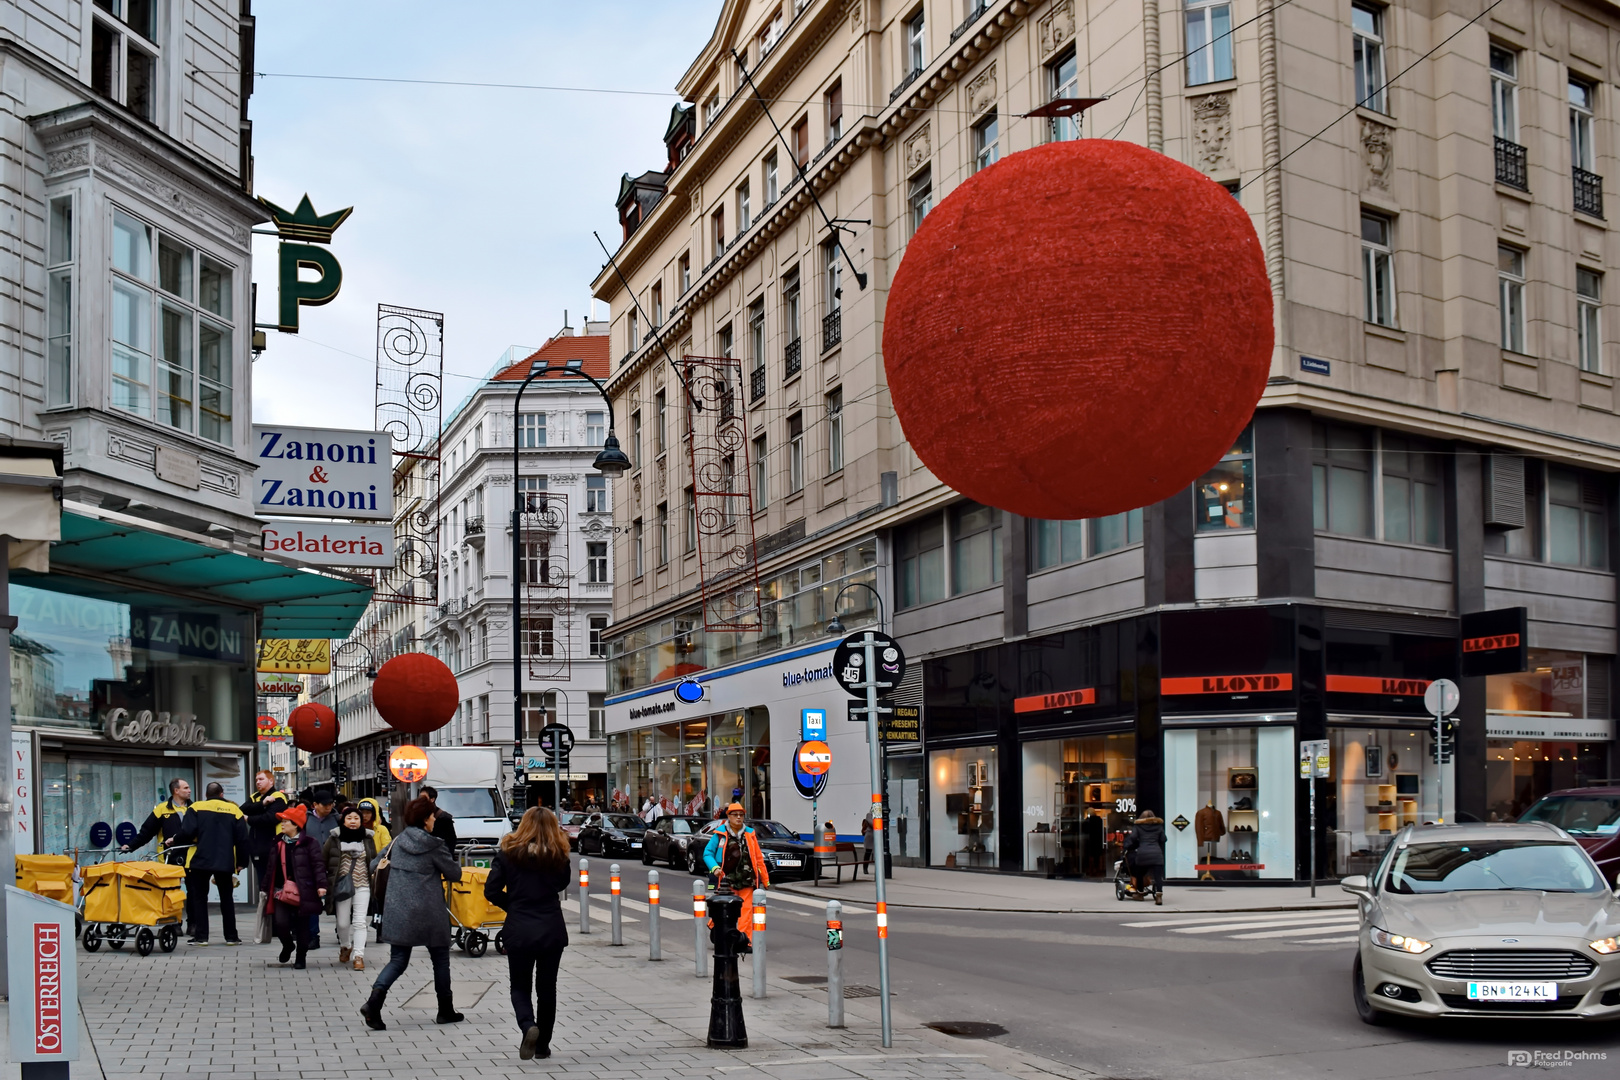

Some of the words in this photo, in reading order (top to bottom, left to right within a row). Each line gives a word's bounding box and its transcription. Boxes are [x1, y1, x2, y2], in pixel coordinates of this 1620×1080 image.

[278, 241, 343, 334] P
[259, 432, 377, 464] Zanoni
[309, 465, 329, 483] &
[260, 479, 378, 510] Zanoni
[262, 529, 384, 555] Gelateria
[133, 618, 145, 639] &
[150, 616, 240, 654] ZANONI
[1465, 636, 1517, 650] LLOYD
[275, 662, 311, 670] BROT
[782, 662, 834, 688] blue-tomat
[1203, 676, 1280, 692] LLOYD
[1382, 679, 1428, 695] LLOYD
[1044, 691, 1083, 708] LLOYD
[629, 701, 676, 720] blue-tomato.com
[897, 708, 918, 717] REGALO
[808, 715, 822, 725] Taxi
[891, 720, 919, 728] PRESENTS
[15, 750, 27, 833] VEGAN
[1116, 798, 1137, 812] 30%
[37, 926, 60, 1050] ÖSTERREICH
[1482, 985, 1498, 996] BN
[1508, 985, 1530, 997] 124
[1533, 985, 1549, 997] KL
